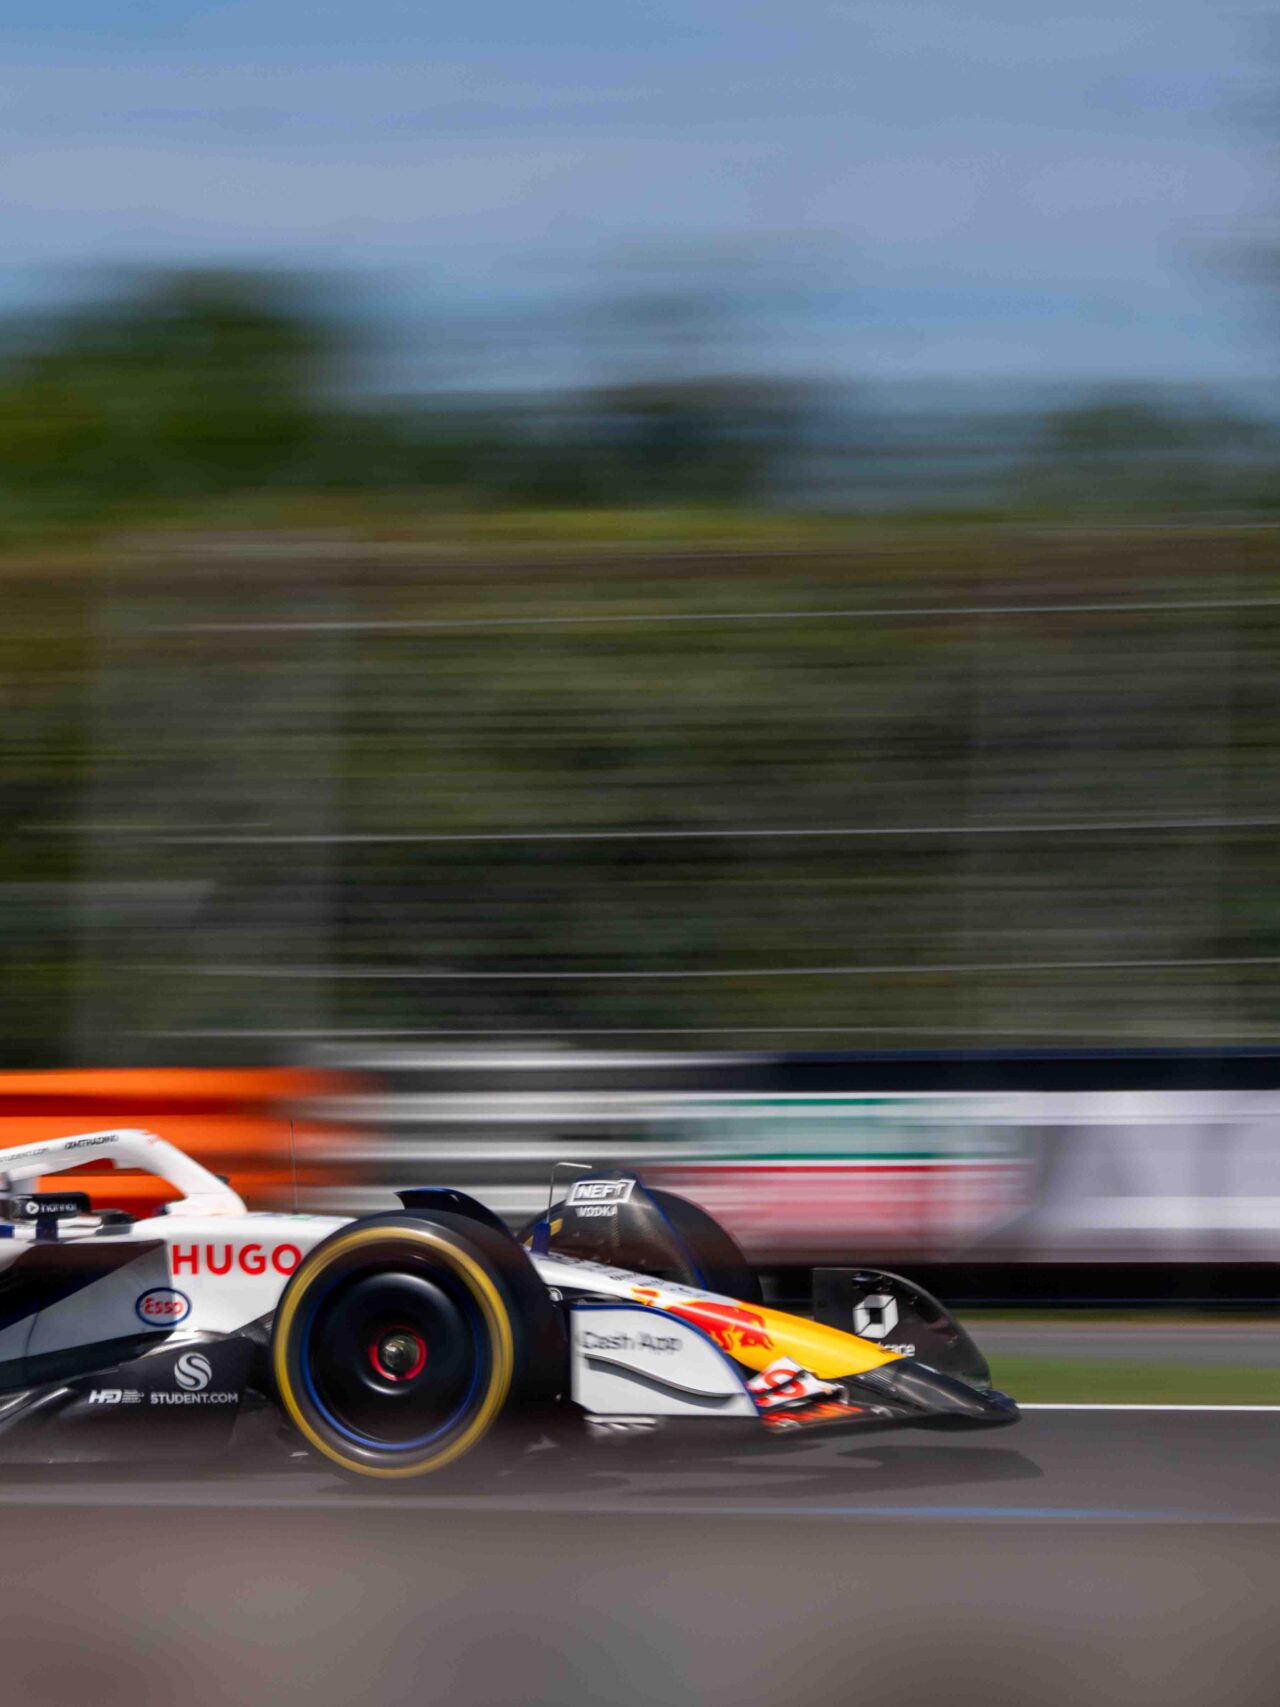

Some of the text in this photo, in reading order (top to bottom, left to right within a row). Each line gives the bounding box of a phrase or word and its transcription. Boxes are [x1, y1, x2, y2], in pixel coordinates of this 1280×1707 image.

[576, 1183, 626, 1199] NEFT
[576, 1205, 618, 1217] VODKA
[172, 1242, 302, 1276] HUGO
[143, 1297, 184, 1315] Esso
[582, 1330, 682, 1356] Cash App
[150, 1391, 239, 1405] STUDENT.COM
